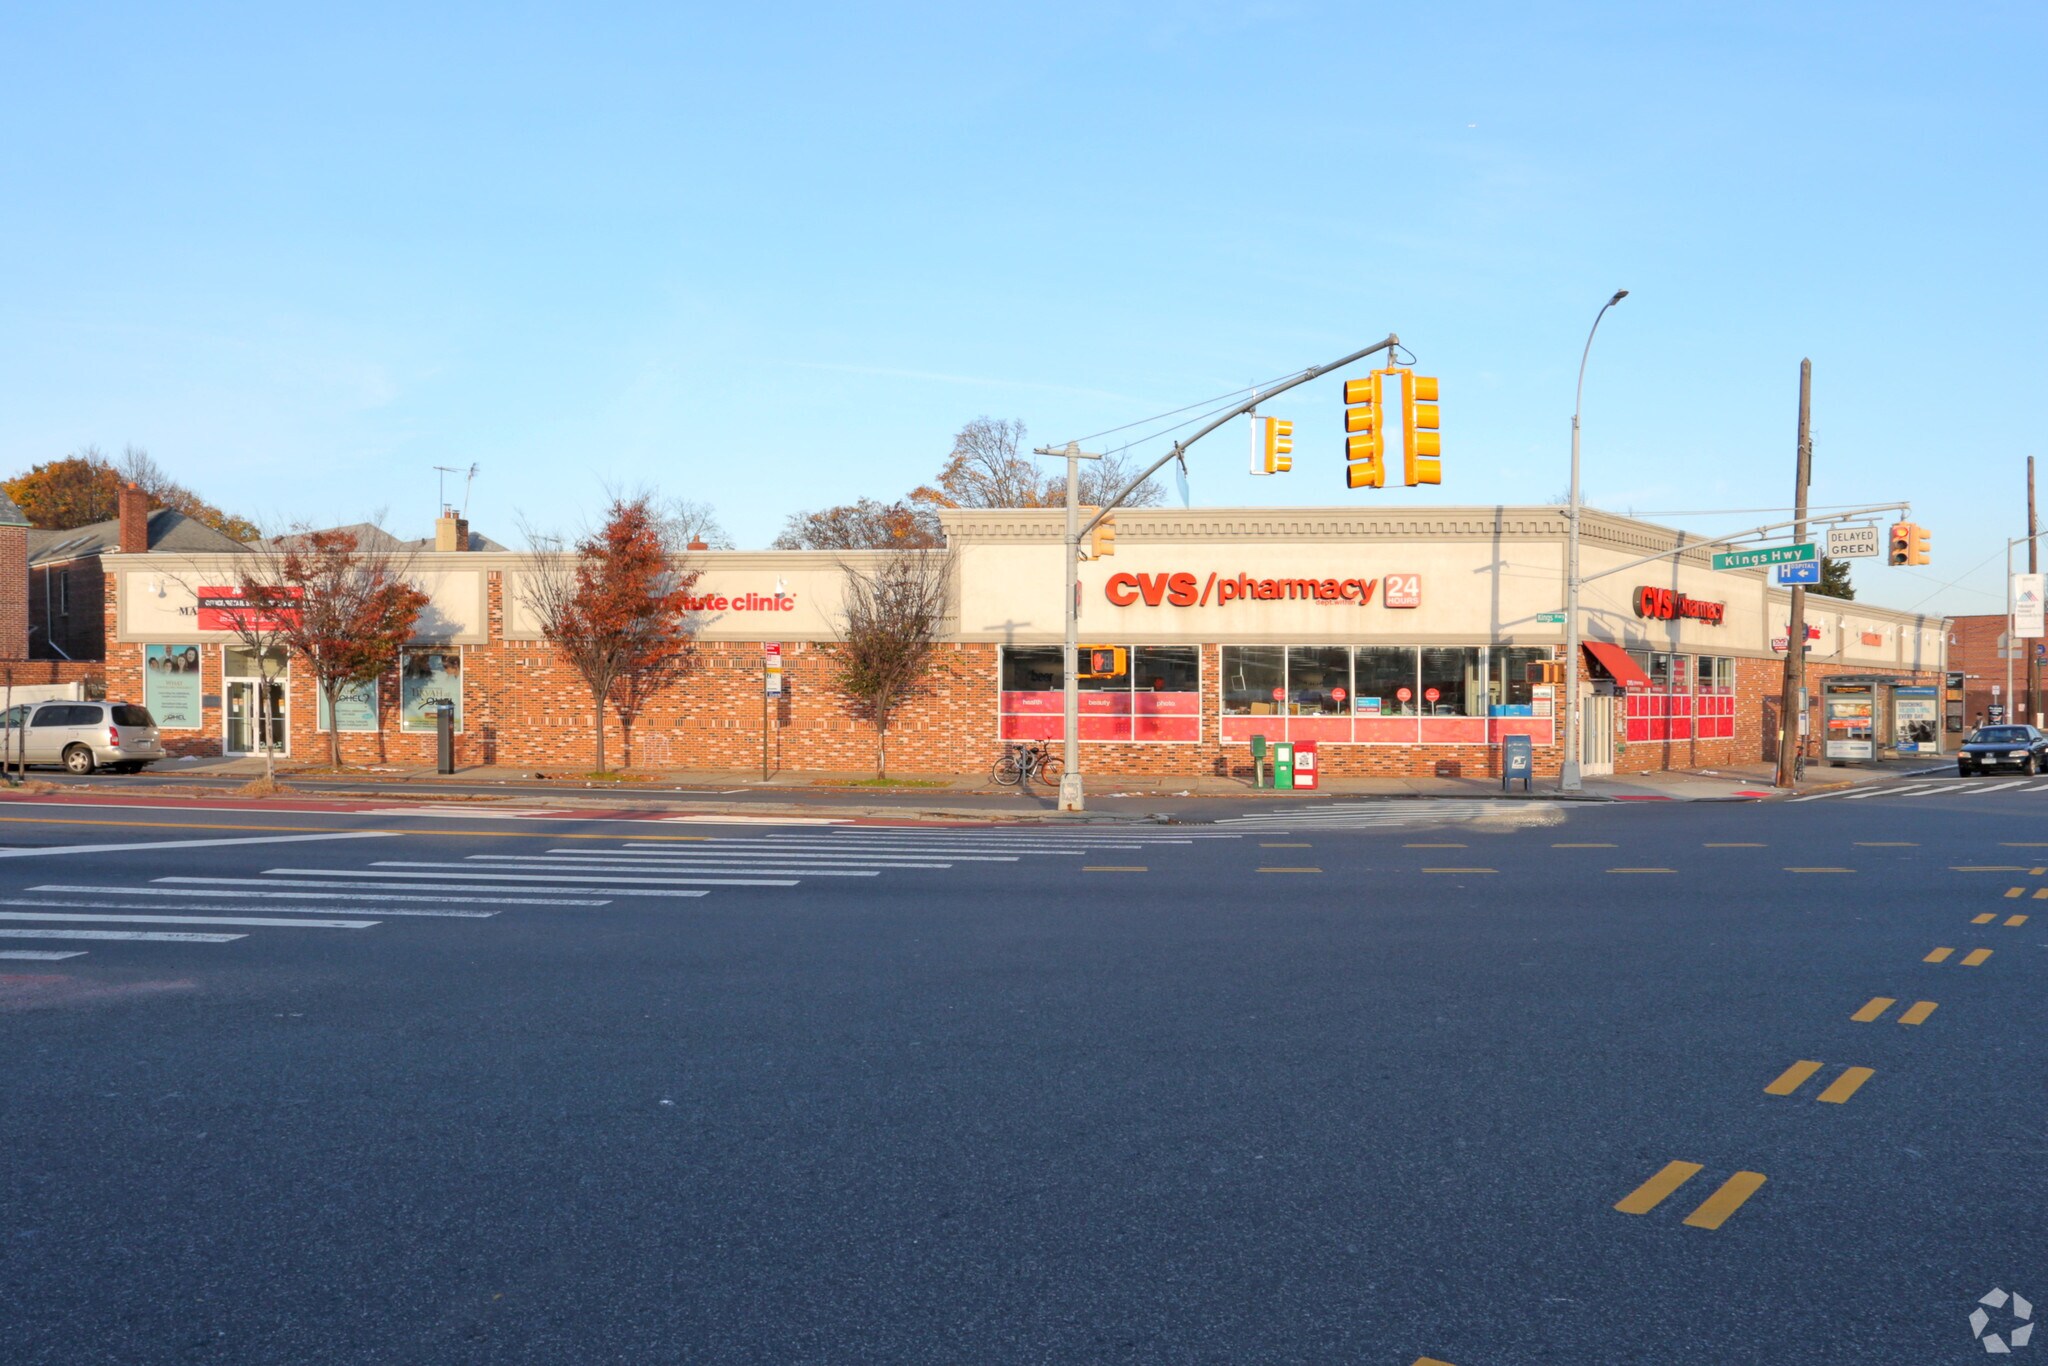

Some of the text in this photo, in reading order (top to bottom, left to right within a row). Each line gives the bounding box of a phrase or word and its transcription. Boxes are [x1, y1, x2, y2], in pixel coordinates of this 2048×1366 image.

[1832, 531, 1873, 542] DELAYED
[1832, 544, 1874, 554] GREEN
[1725, 549, 1802, 567] Kings Hwy
[1781, 563, 1815, 578] HOSPITAL
[1388, 576, 1419, 597] 24
[732, 593, 794, 611] clinic
[1388, 597, 1419, 605] HOURS
